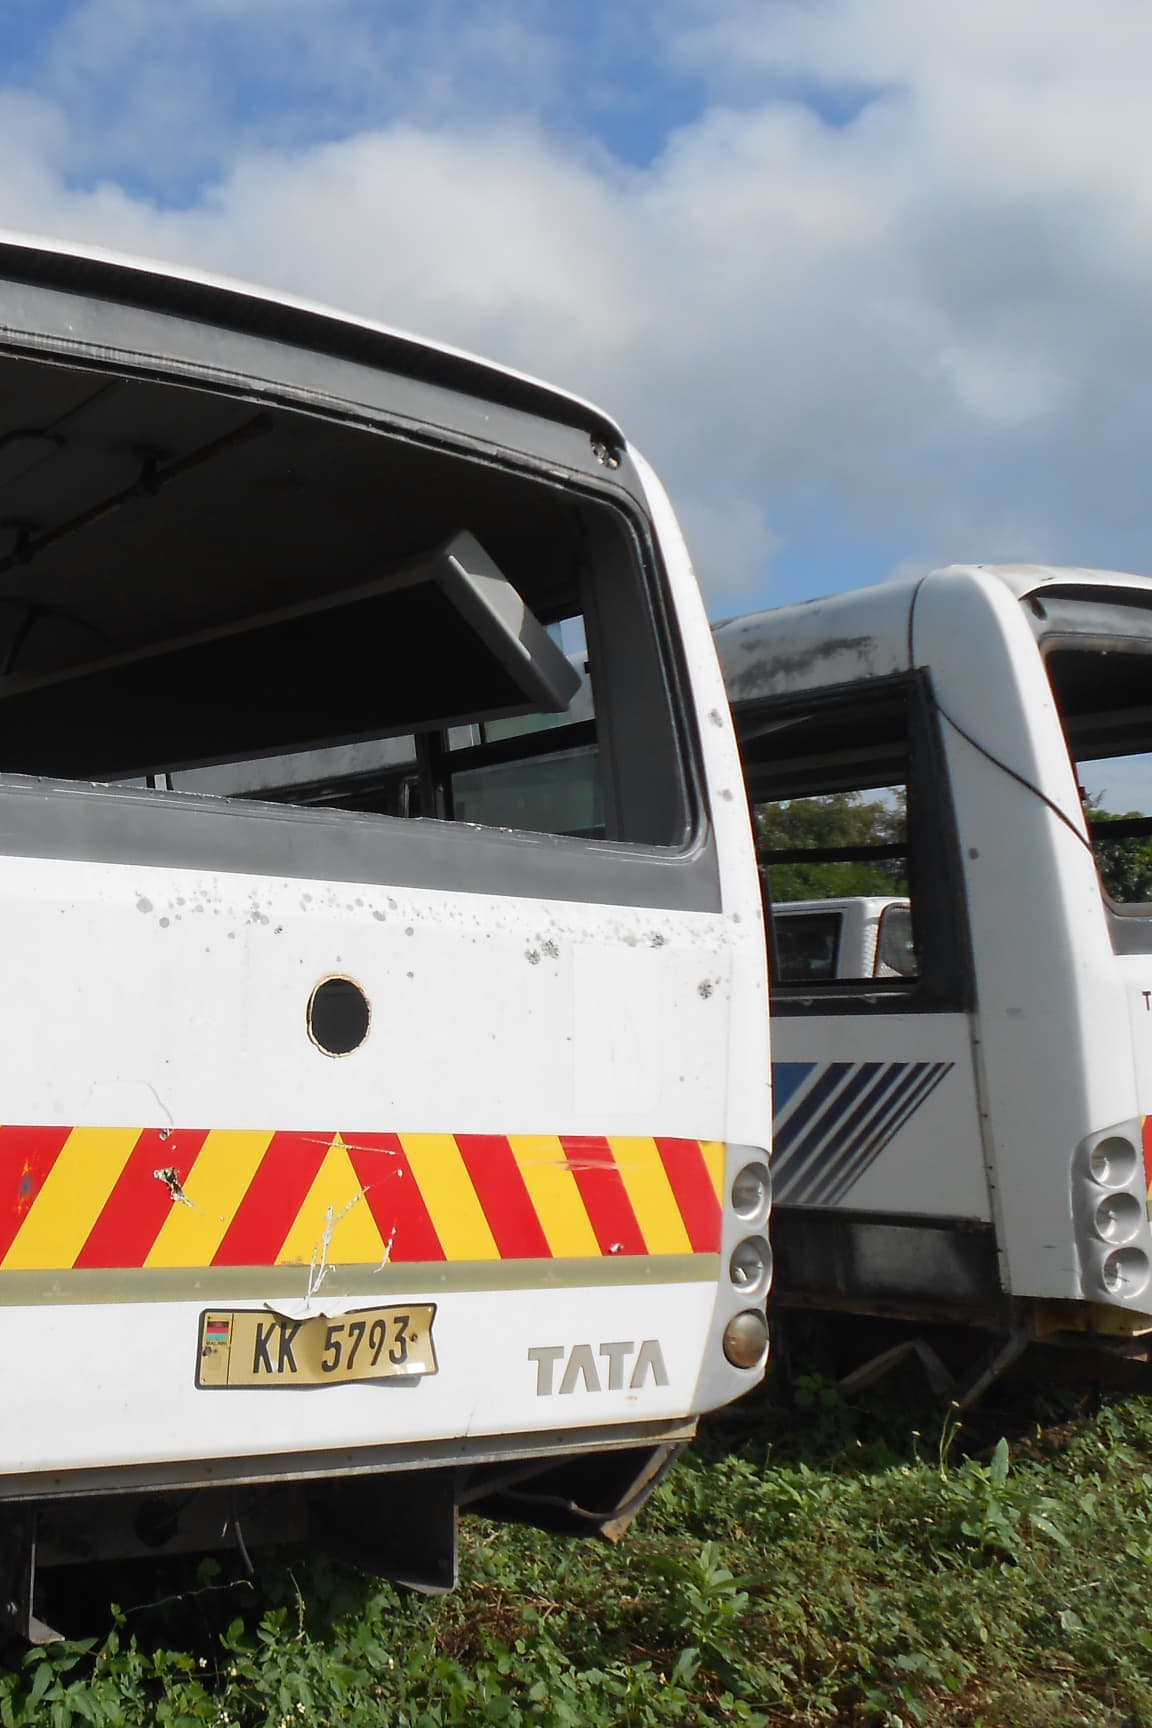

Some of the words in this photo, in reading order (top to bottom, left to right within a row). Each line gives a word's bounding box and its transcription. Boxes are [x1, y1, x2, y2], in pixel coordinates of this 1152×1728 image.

[253, 1321, 303, 1374] KK
[321, 1315, 410, 1373] 5793
[528, 1340, 669, 1396] TATA
